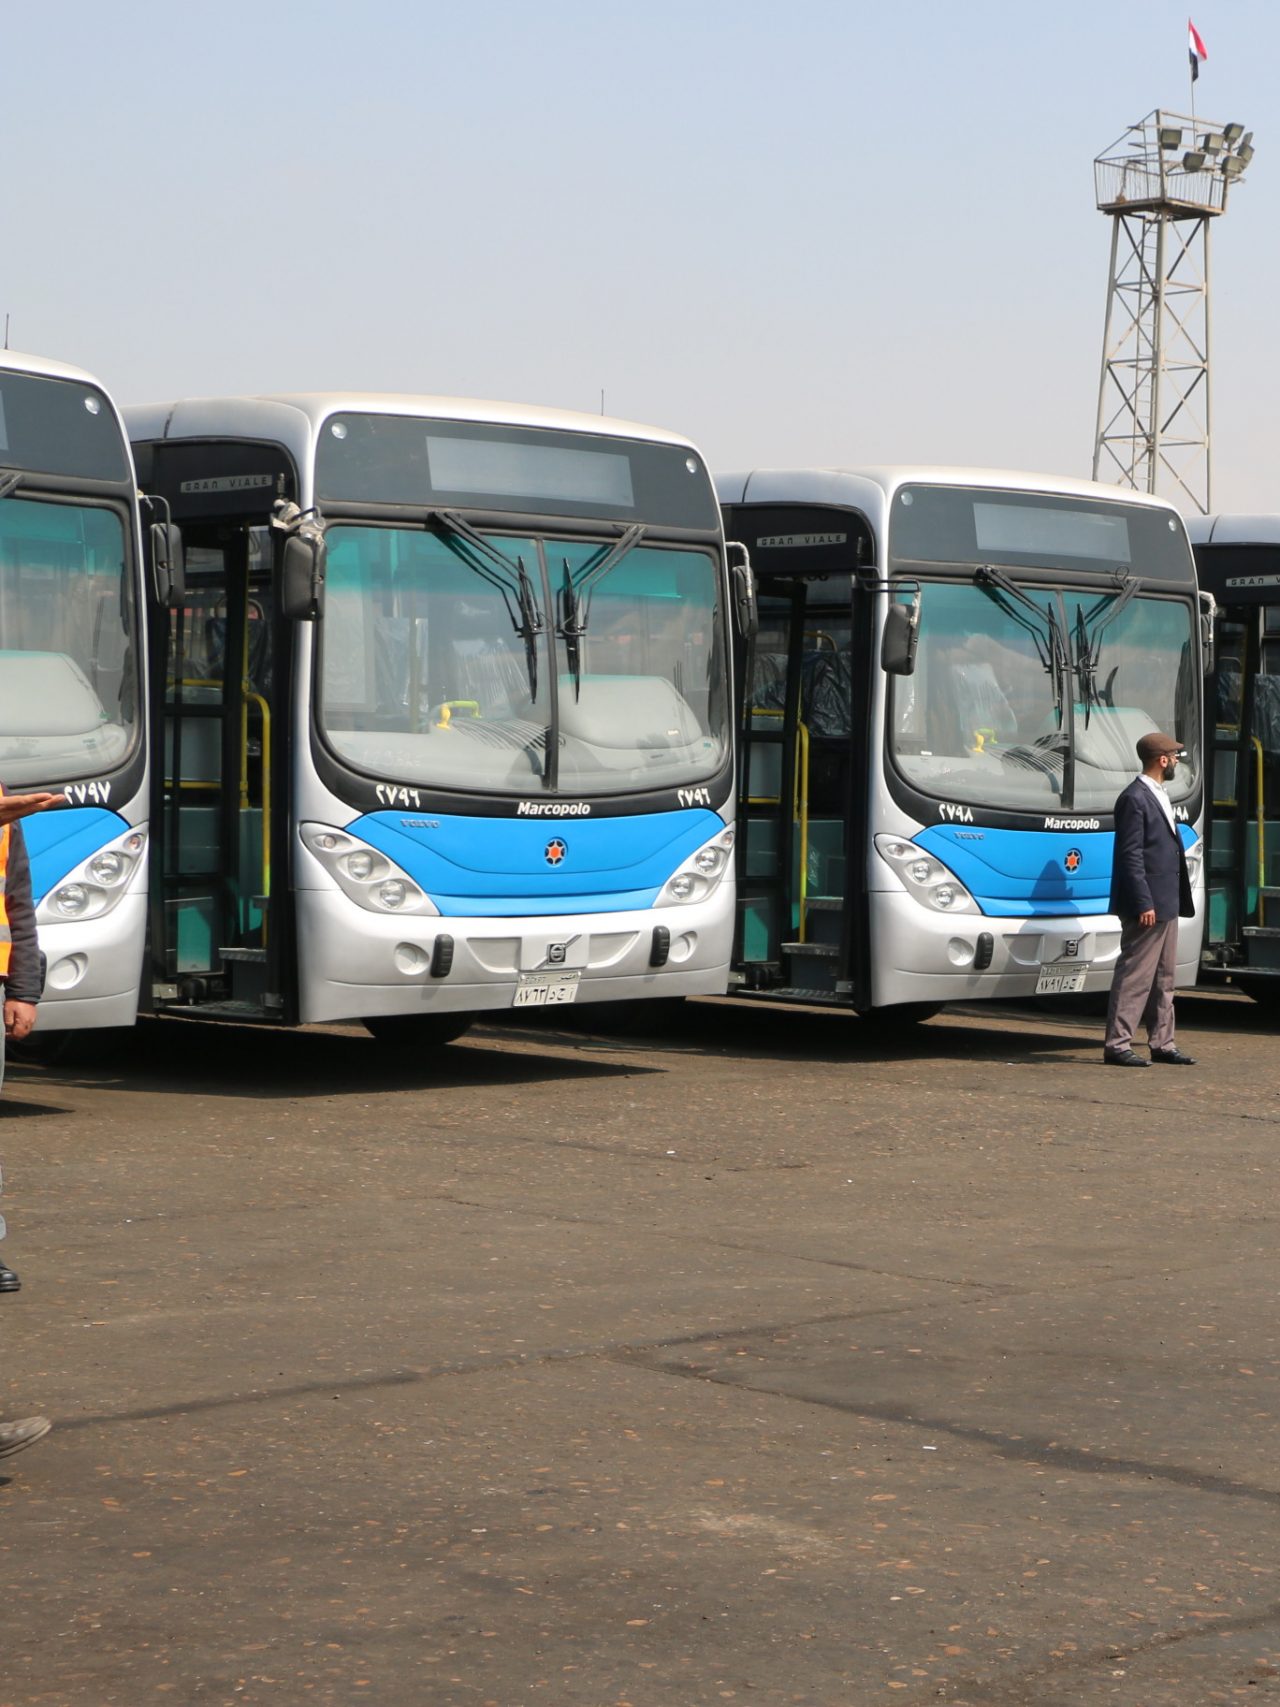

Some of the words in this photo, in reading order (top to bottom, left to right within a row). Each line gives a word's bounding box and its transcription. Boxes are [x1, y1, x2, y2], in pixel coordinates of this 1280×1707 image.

[229, 477, 267, 488] VIALE
[804, 534, 842, 544] VIALE
[63, 781, 111, 805] ٢٧٩٧
[516, 802, 591, 816] Marcopolo
[399, 818, 440, 829] VOLVO
[1043, 817, 1100, 831] Marcopolo
